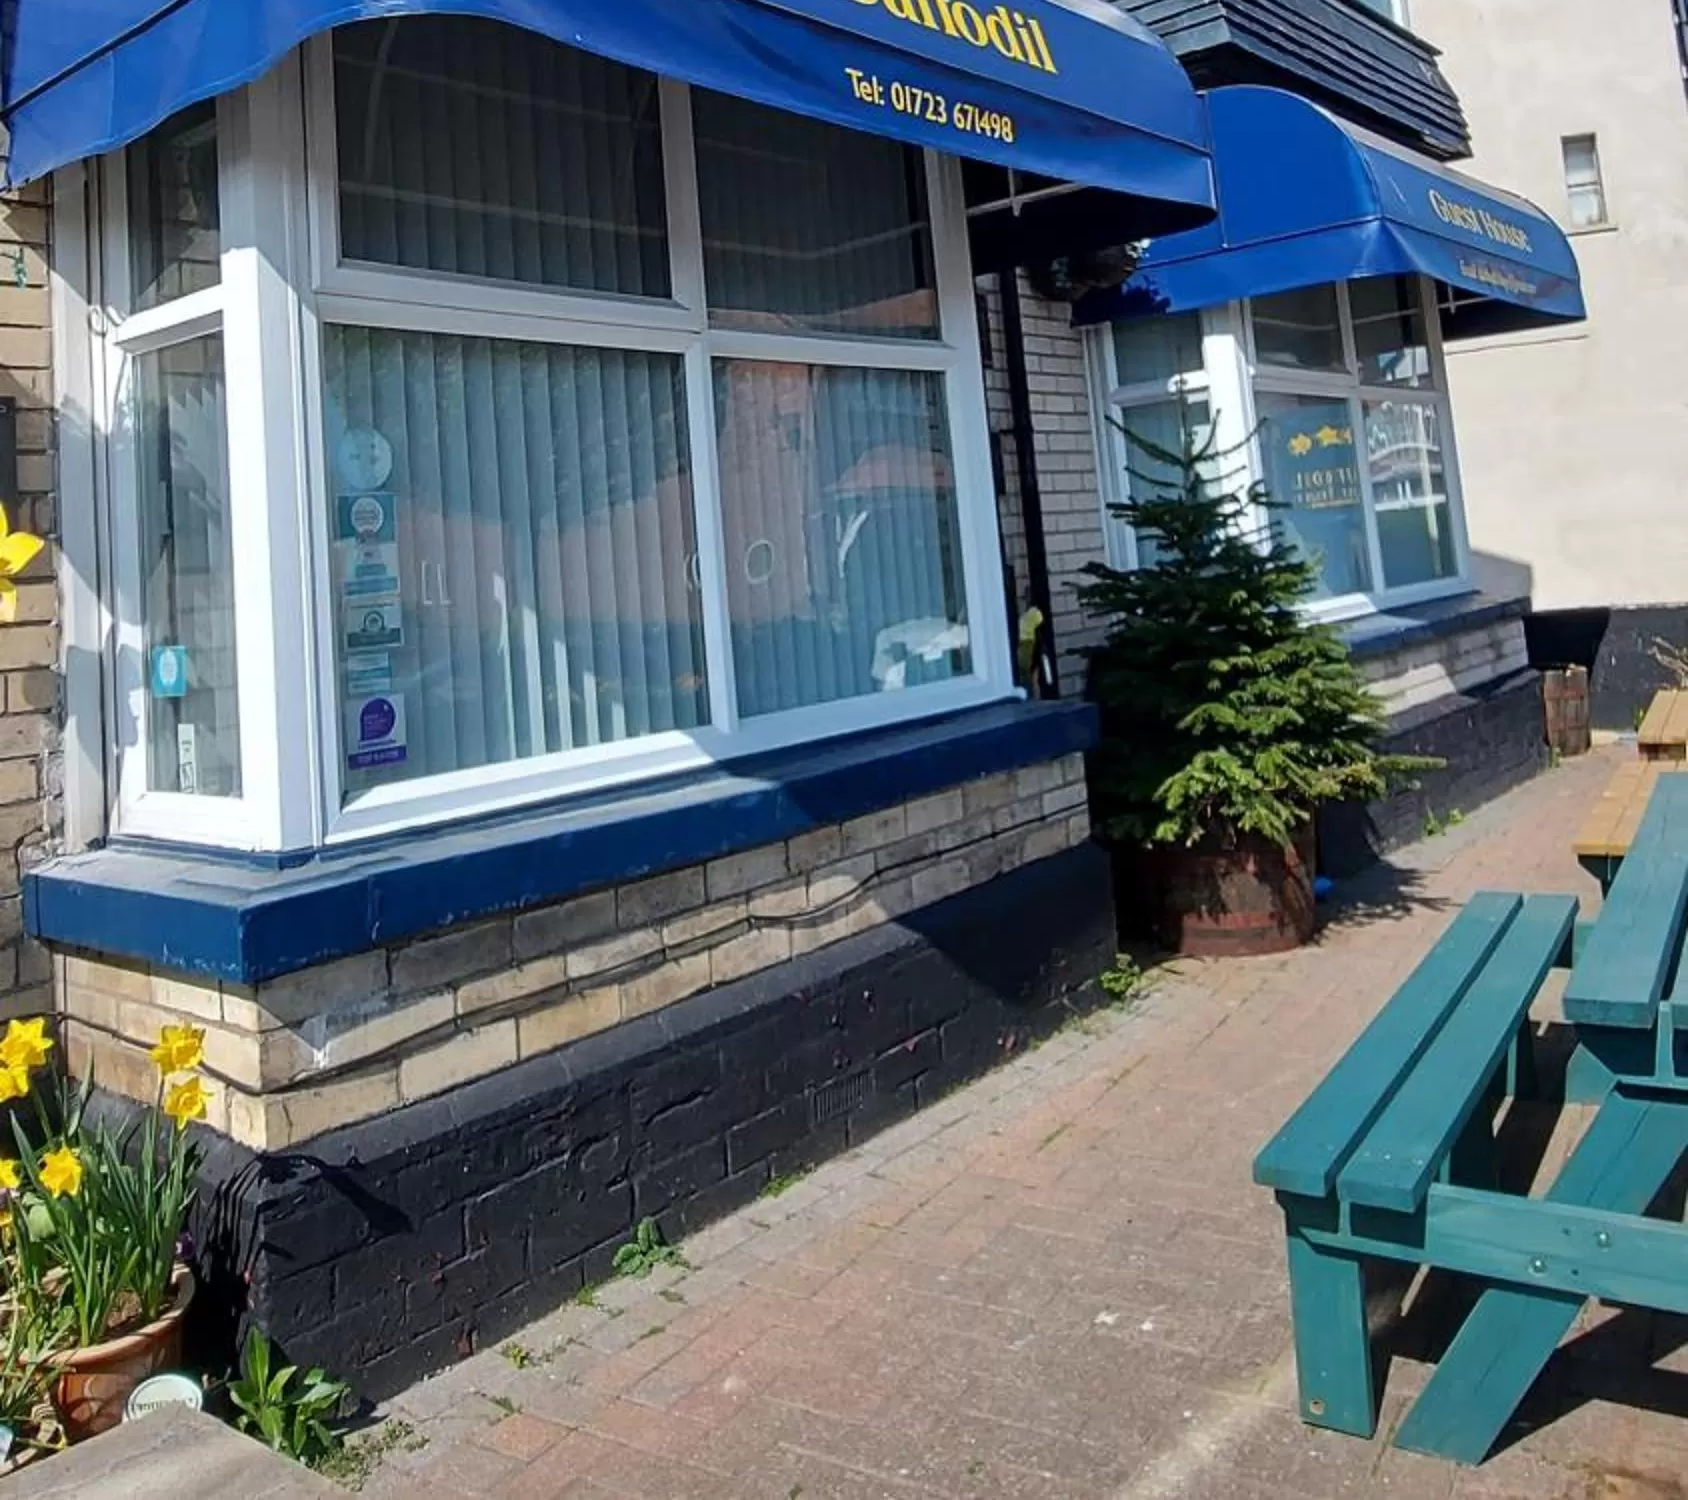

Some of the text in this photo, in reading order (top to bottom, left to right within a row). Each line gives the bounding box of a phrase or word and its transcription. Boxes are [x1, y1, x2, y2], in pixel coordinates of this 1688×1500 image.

[844, 67, 1014, 143] Tel: 01723 671498
